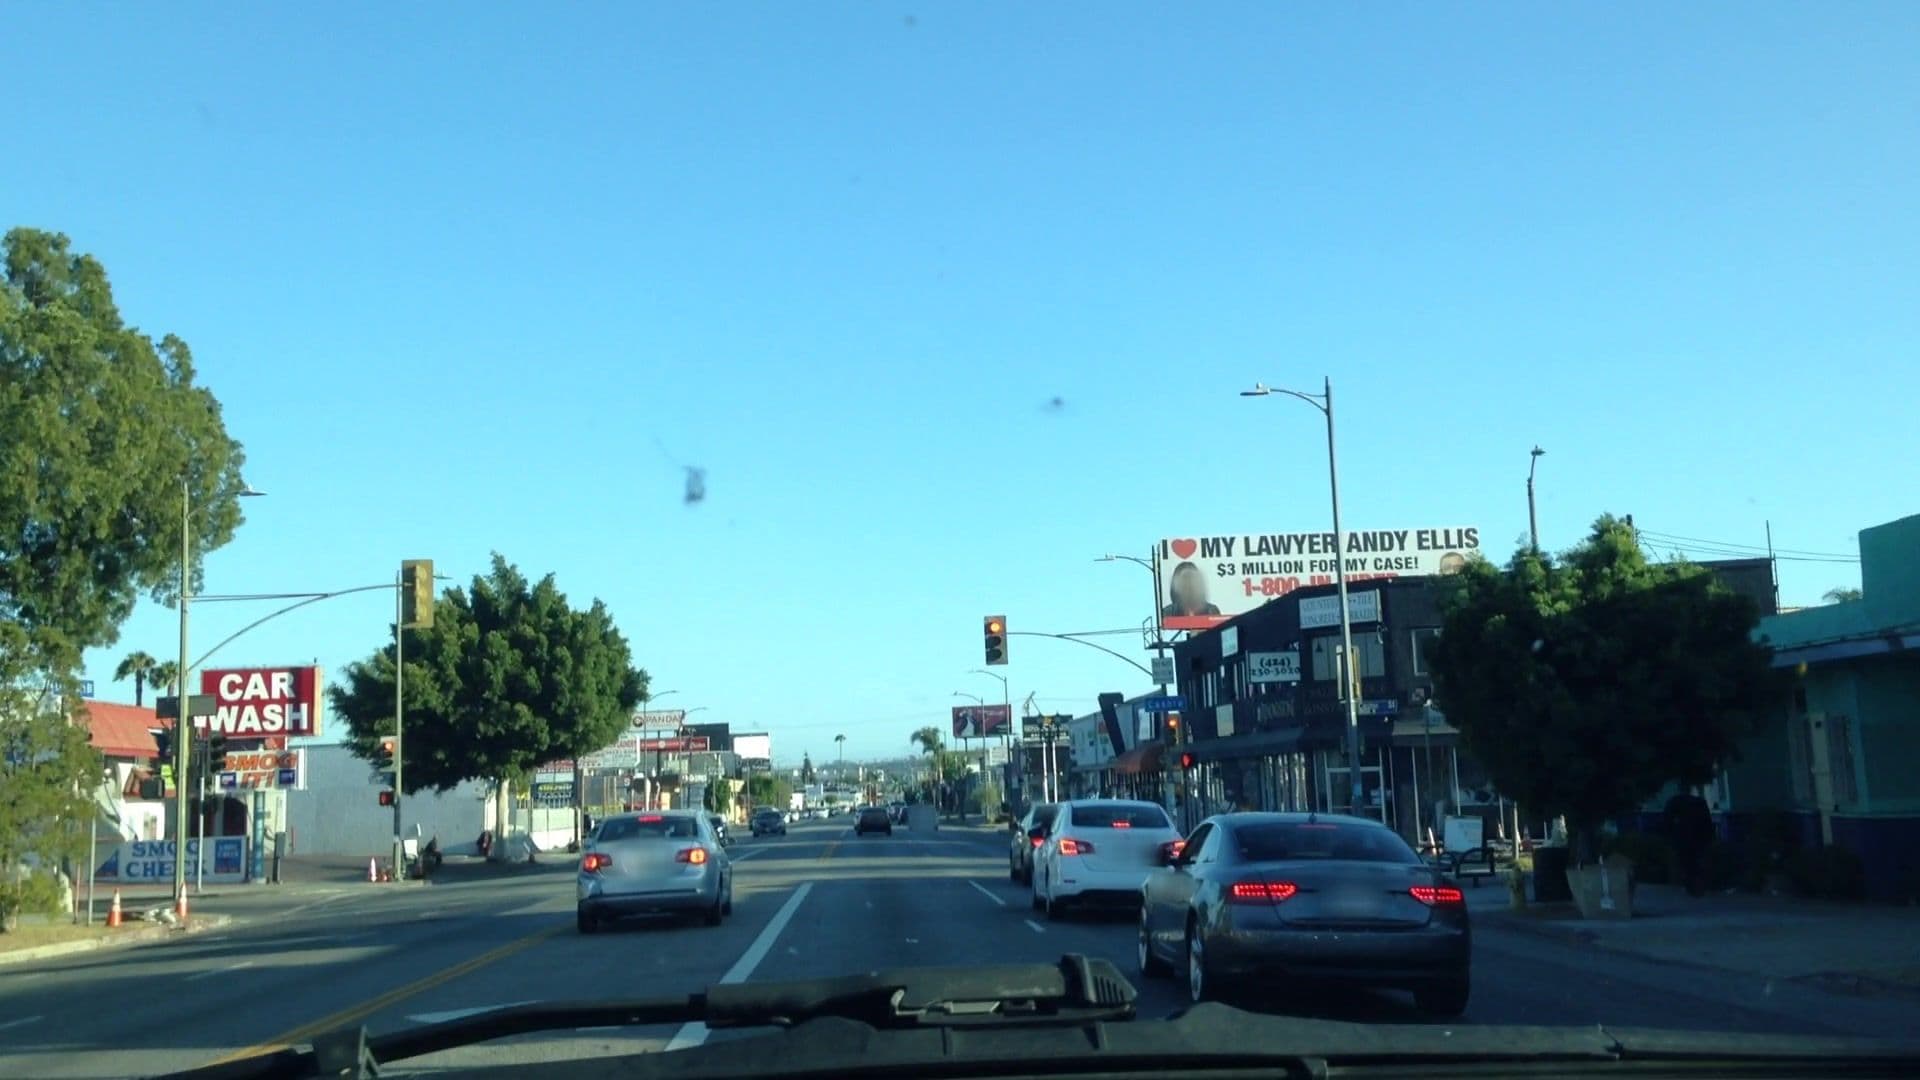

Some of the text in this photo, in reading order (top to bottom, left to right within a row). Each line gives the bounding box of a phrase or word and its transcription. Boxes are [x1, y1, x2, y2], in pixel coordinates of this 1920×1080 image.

[1162, 528, 1479, 560] I MY LAWYER ANDY ELLIS
[1217, 556, 1418, 578] $3 MILLION FOR MY CASE!
[219, 672, 295, 701] CAR
[209, 703, 308, 733] WASH
